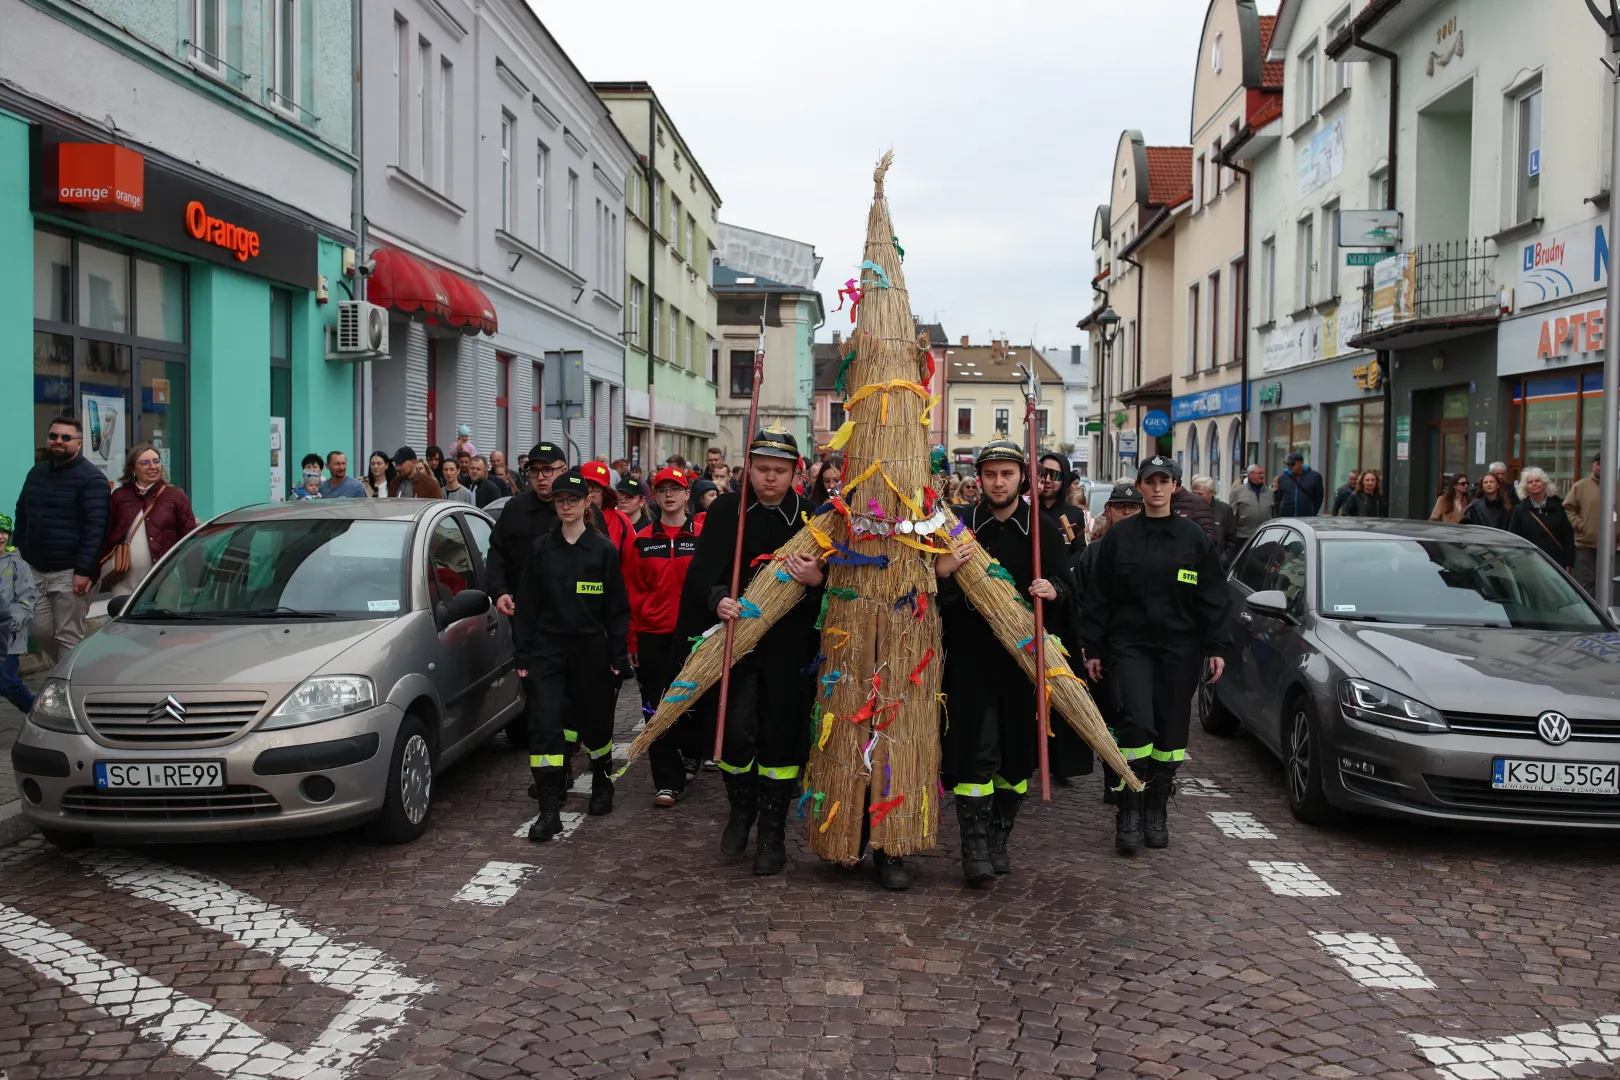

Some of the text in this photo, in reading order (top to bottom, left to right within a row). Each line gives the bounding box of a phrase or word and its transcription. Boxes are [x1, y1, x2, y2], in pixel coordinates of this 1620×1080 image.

[1436, 15, 1457, 45] 2001
[61, 187, 109, 200] orange
[115, 190, 141, 207] orange
[186, 201, 260, 262] Orange
[1535, 237, 1566, 267] Brudny
[1537, 308, 1607, 360] APTE
[163, 764, 219, 787] RE99
[1508, 762, 1616, 787] KSU 55G4
